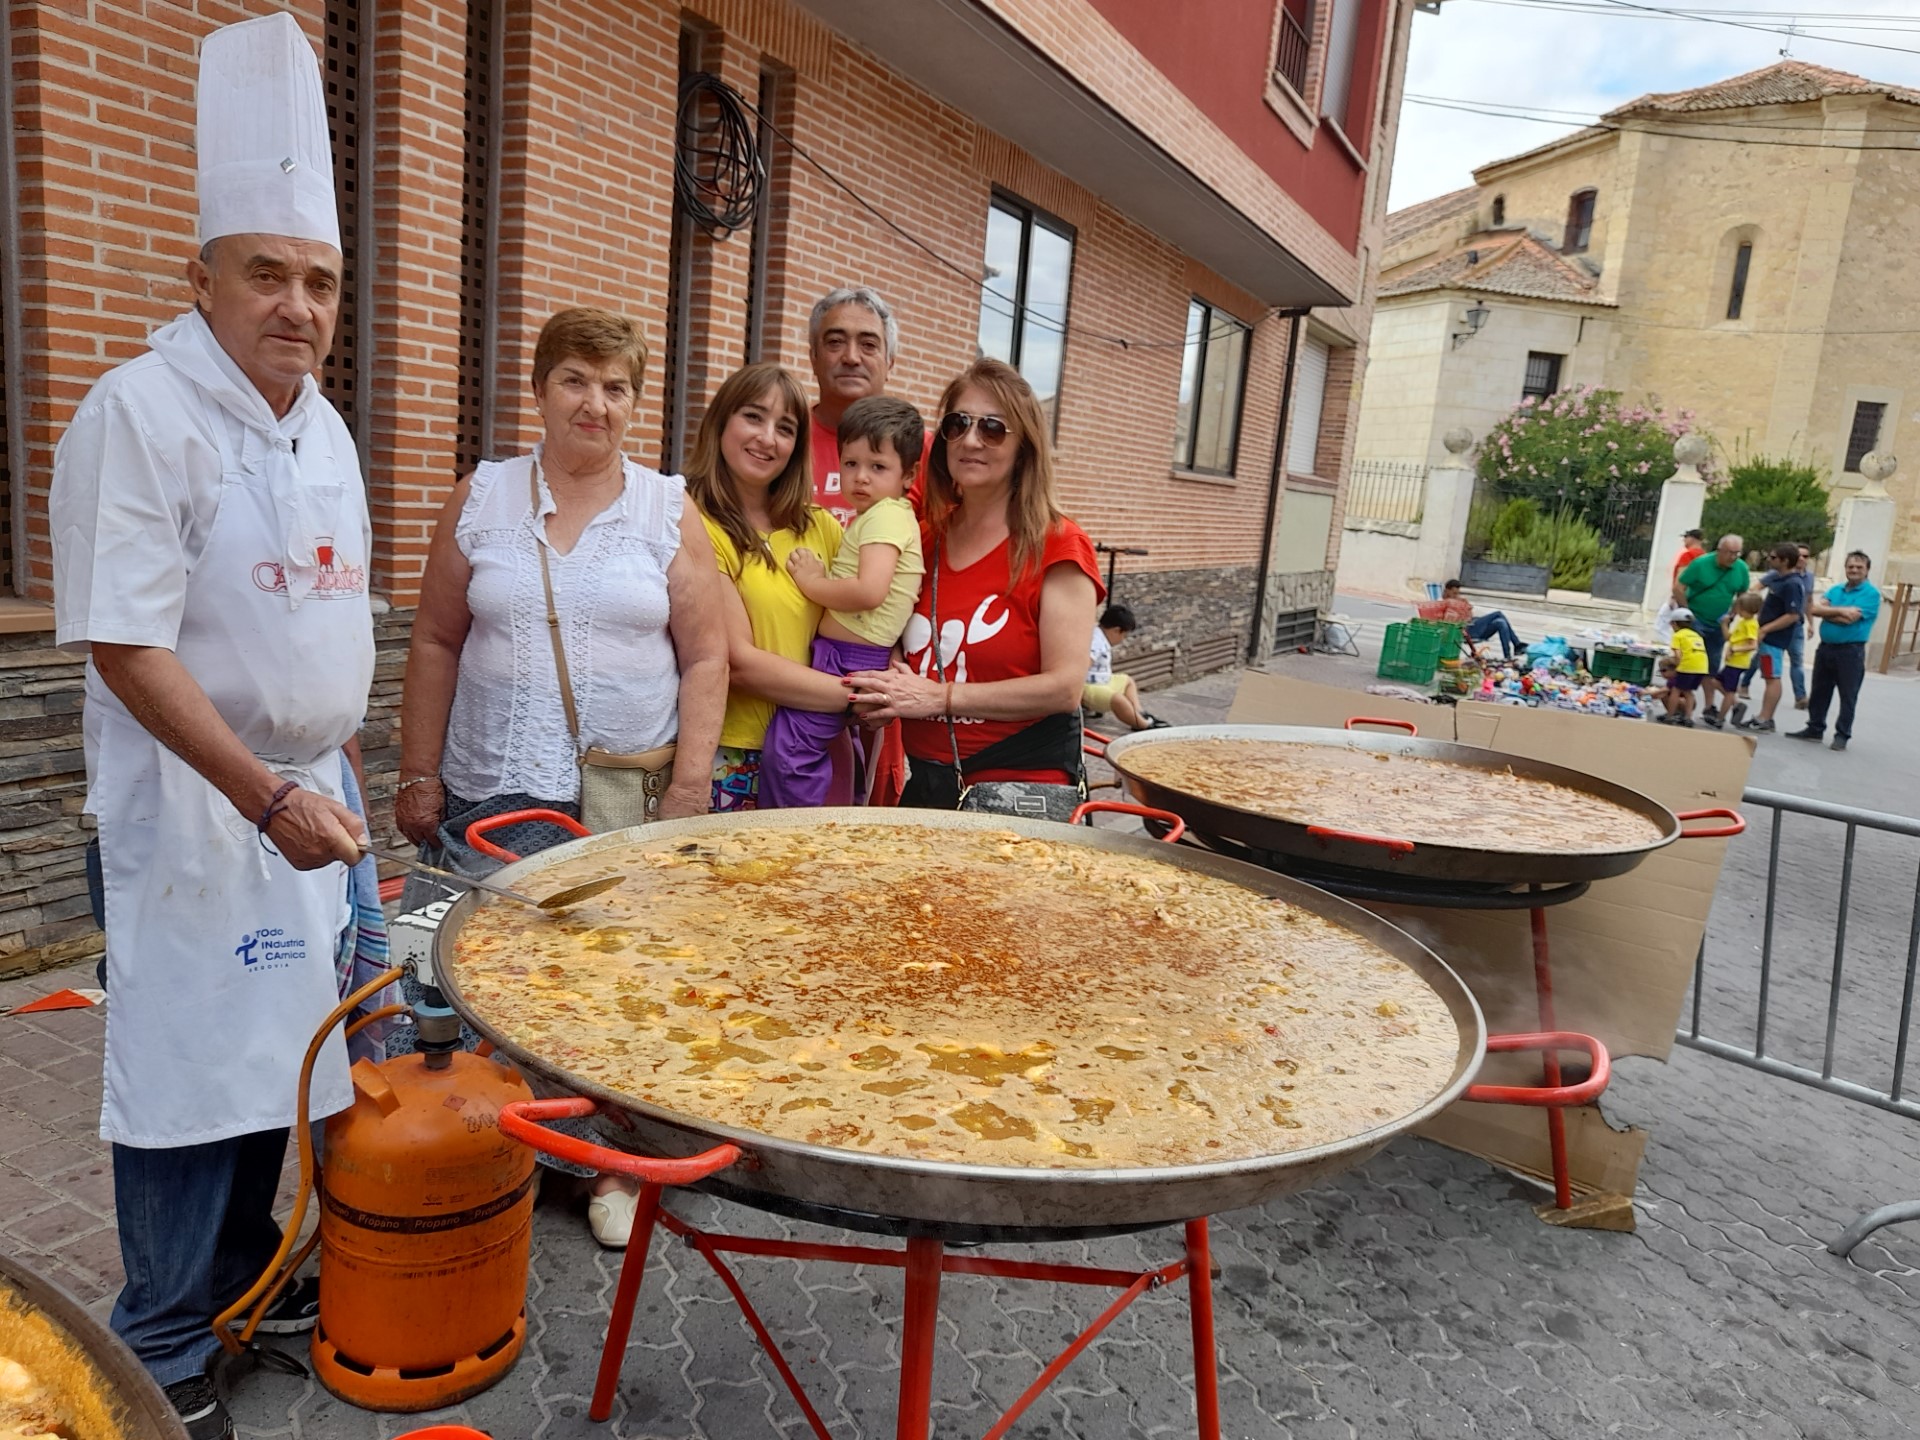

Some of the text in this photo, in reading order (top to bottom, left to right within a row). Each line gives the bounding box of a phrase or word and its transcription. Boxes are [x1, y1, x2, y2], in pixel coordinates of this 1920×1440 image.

[255, 928, 284, 939] TOdo
[261, 939, 305, 950] INdustria
[358, 1213, 400, 1229] Propano
[415, 1216, 460, 1229] Propano
[474, 1197, 511, 1219] Propano
